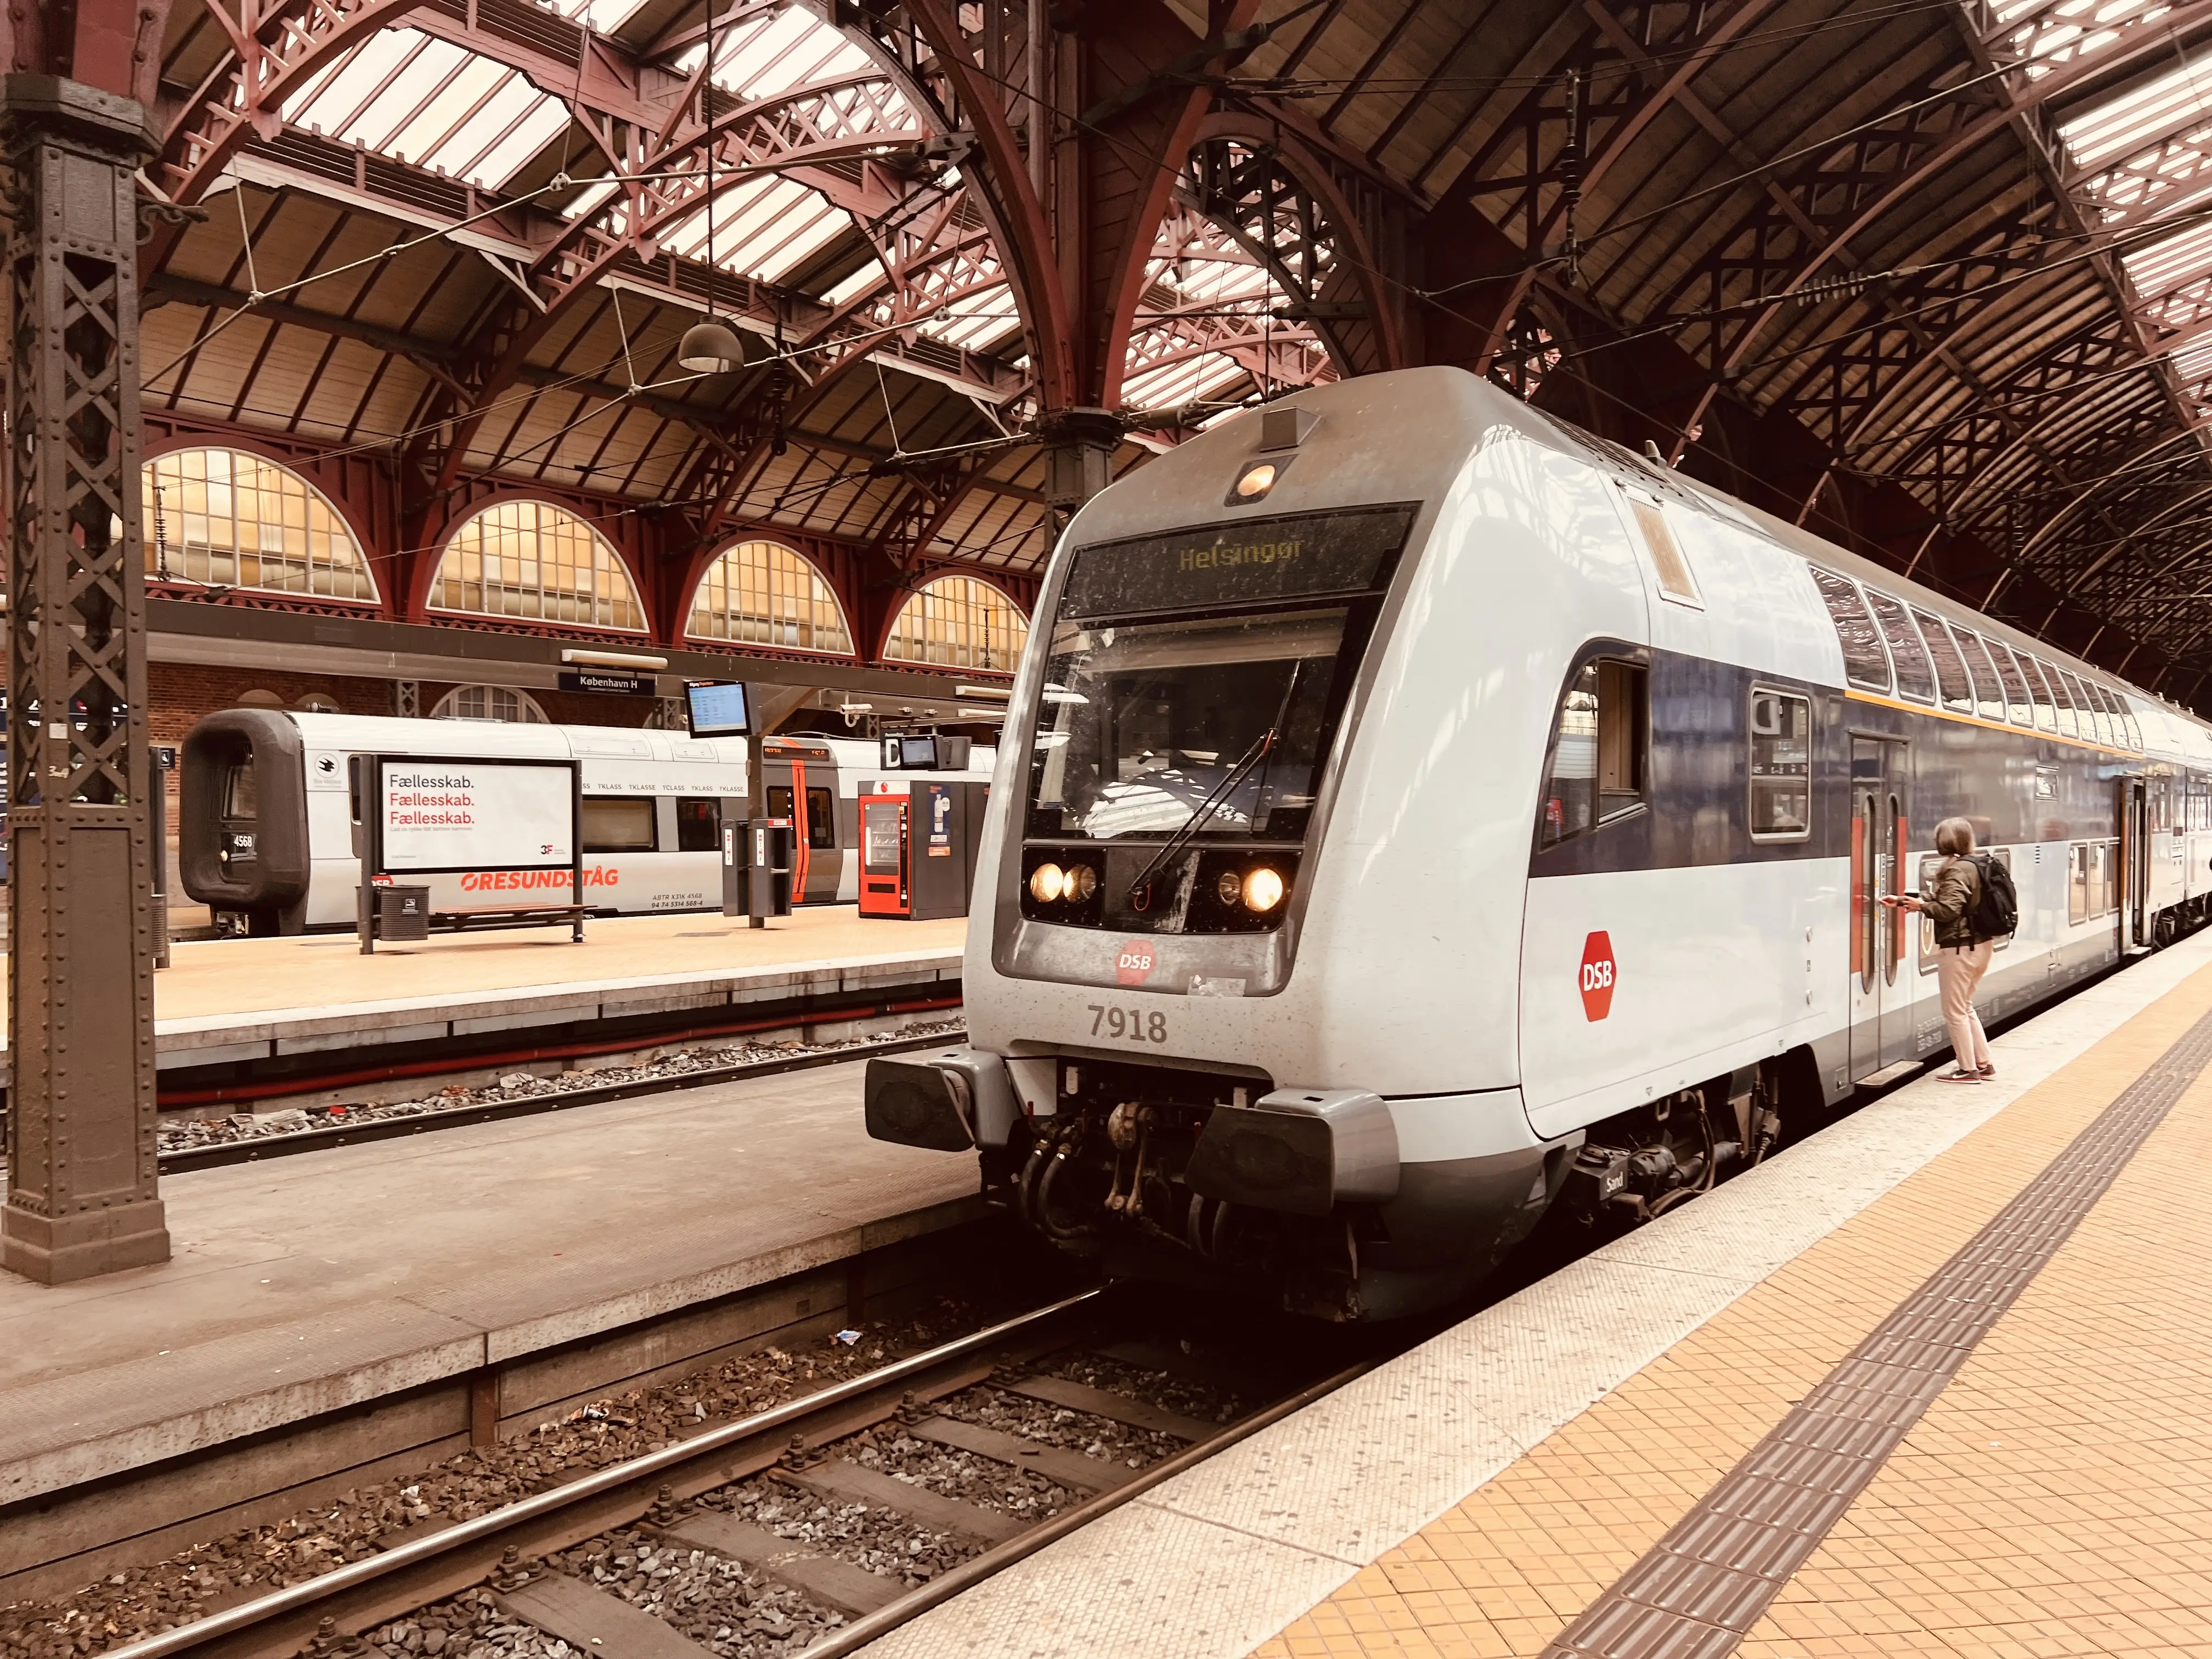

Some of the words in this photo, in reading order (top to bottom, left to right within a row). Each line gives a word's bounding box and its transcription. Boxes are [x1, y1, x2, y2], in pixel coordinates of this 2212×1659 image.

[1180, 541, 1302, 571] Helsingør
[580, 676, 629, 688] København
[631, 680, 637, 689] H
[390, 775, 474, 788] Fællesskab.
[390, 793, 474, 806] Fællesskab.
[390, 811, 474, 824] Fællesskab.
[234, 835, 252, 847] 4568
[540, 845, 553, 854] 3F
[1119, 954, 1152, 970] DSB
[1583, 960, 1613, 991] DSB
[1088, 1005, 1167, 1043] 7918
